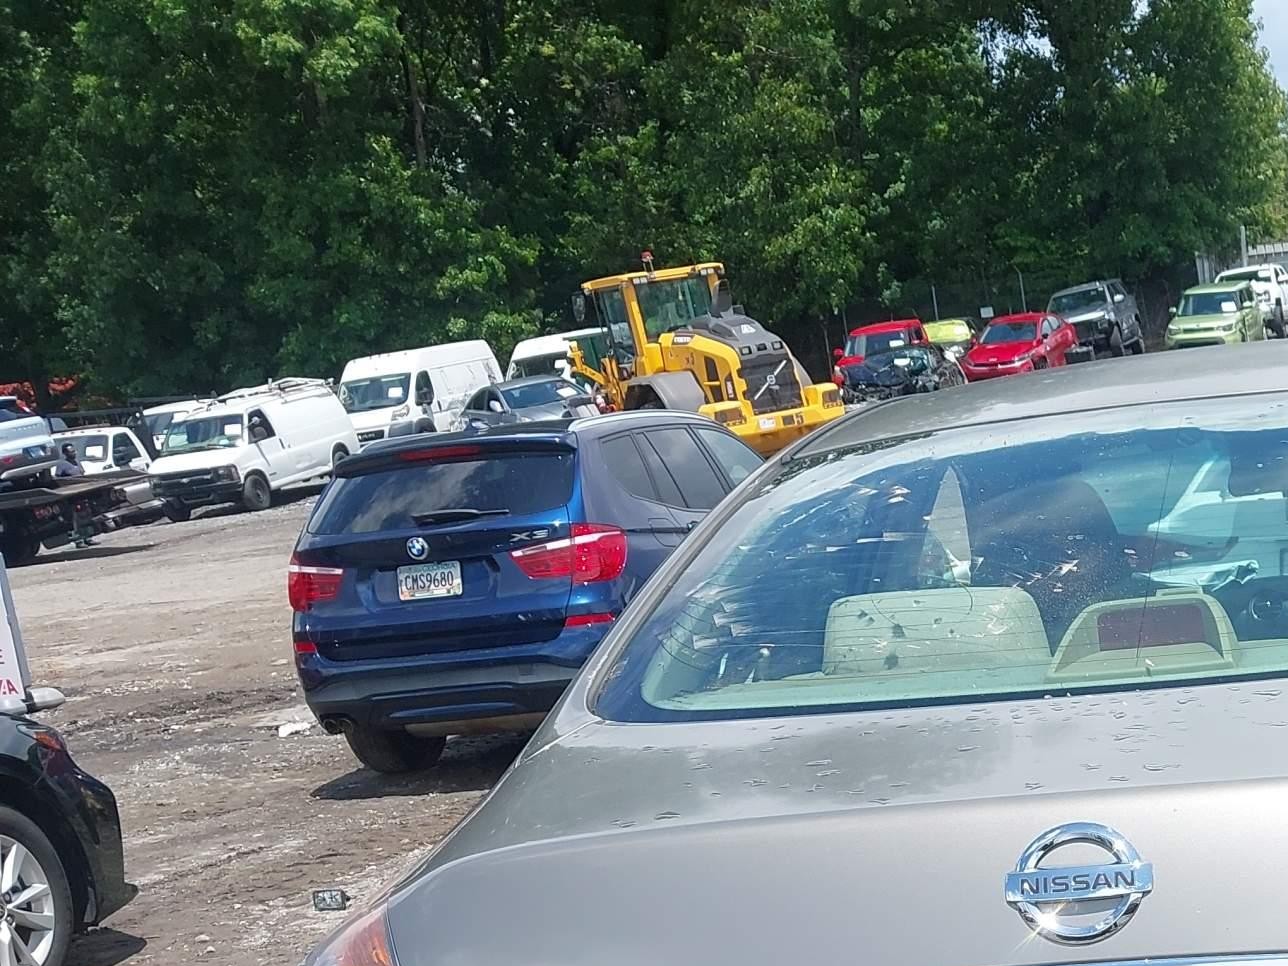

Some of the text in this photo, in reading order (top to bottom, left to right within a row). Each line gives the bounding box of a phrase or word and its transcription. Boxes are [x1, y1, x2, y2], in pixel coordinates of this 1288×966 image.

[510, 529, 549, 542] X3
[404, 570, 454, 591] CMS9680
[1020, 870, 1135, 895] NISSAN
